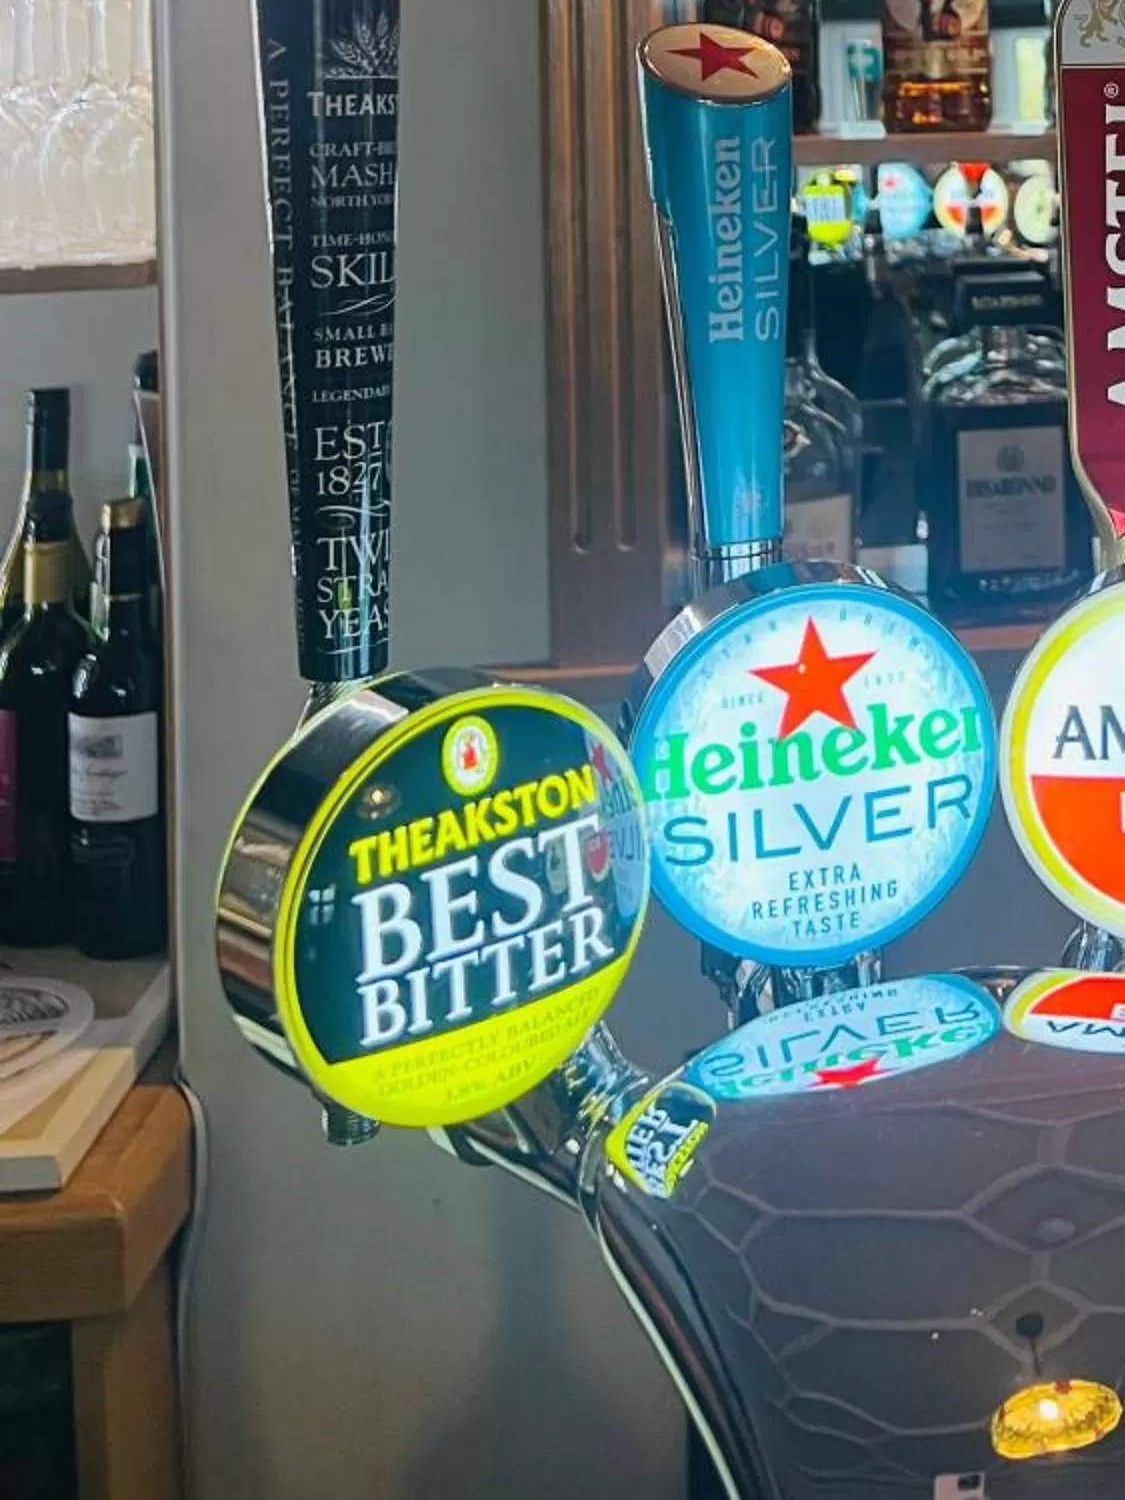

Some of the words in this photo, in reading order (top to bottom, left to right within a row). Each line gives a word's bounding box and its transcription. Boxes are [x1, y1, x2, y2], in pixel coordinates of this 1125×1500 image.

[708, 135, 745, 345] Heineken
[751, 135, 781, 343] SILVER
[317, 460, 382, 496] 1827
[316, 529, 390, 571] TWI
[317, 570, 389, 603] STRA
[348, 763, 598, 887] THEAKSTON
[663, 773, 973, 868] SILVER
[351, 811, 602, 985] BEST
[752, 880, 898, 920] REFRESHING
[788, 863, 862, 891] EXTRA
[793, 911, 861, 937] TASTE
[357, 905, 615, 1047] BITTER
